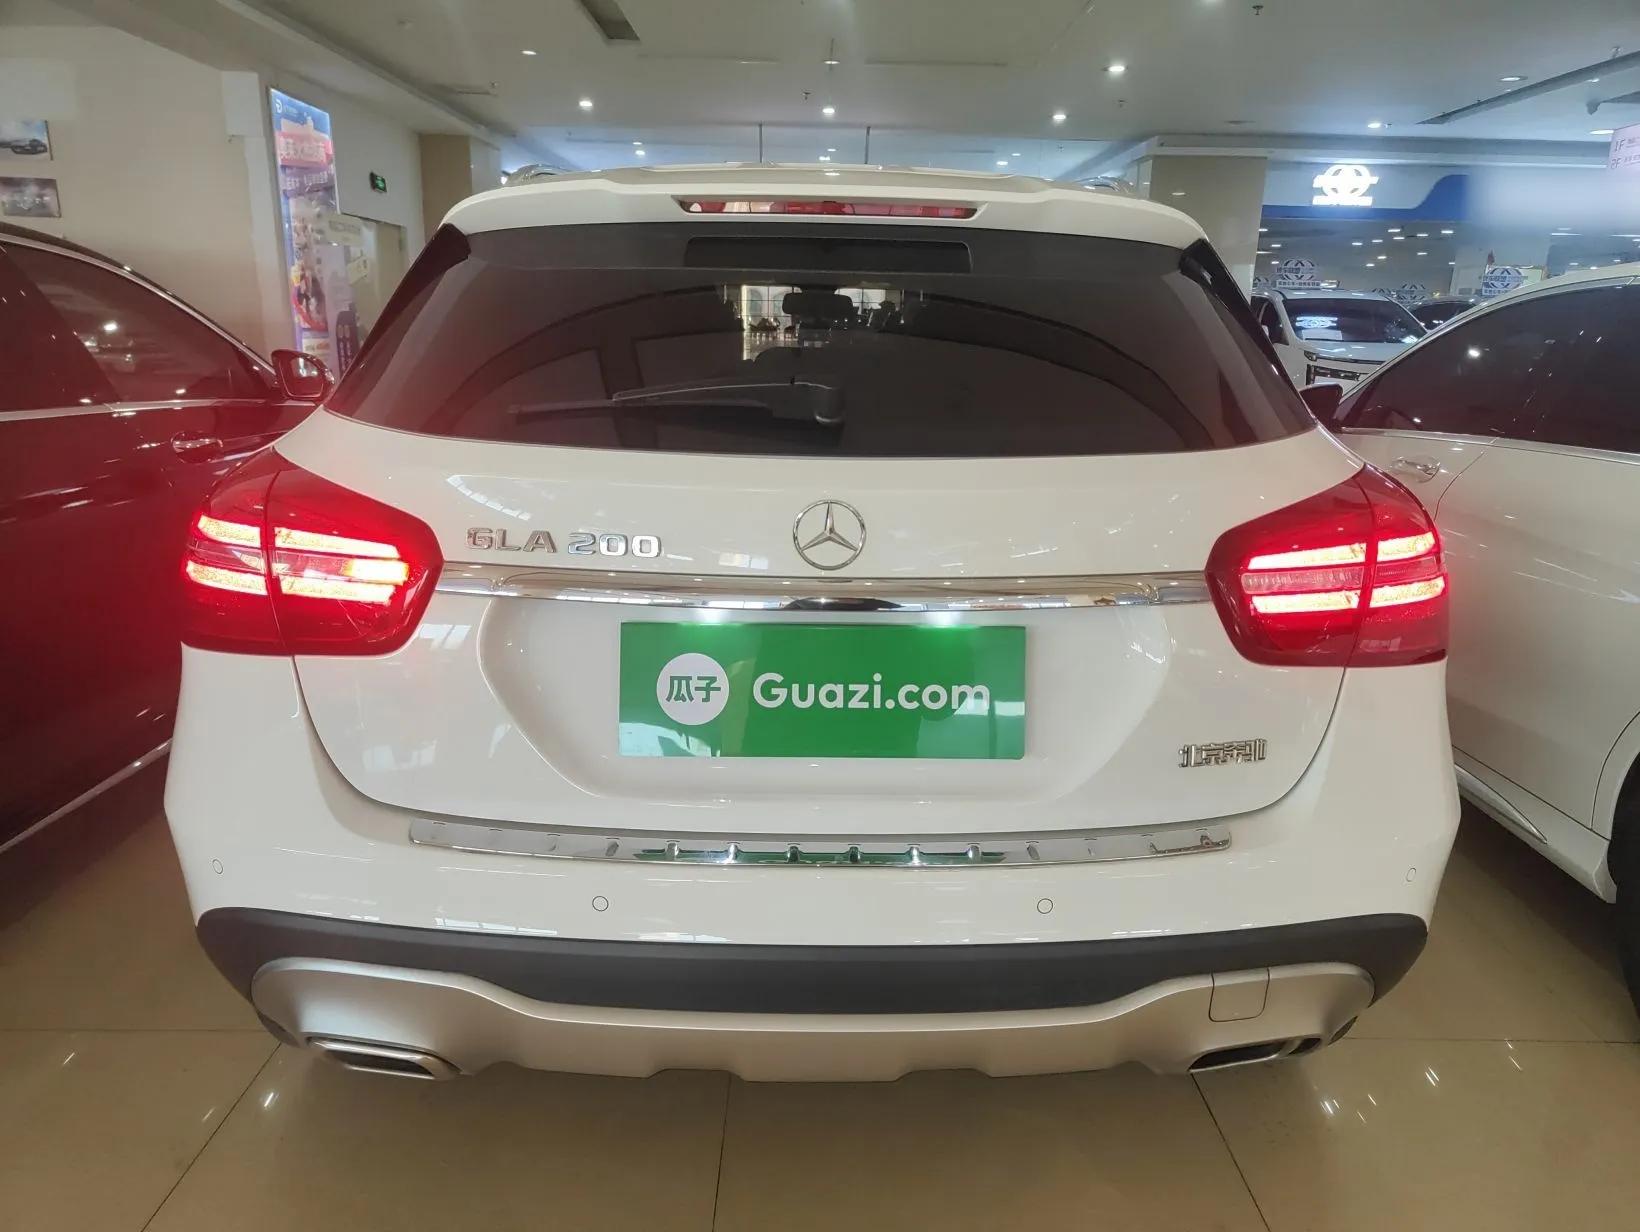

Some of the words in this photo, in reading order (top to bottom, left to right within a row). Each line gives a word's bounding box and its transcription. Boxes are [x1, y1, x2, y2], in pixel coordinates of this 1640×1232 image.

[466, 527, 557, 553] GLA
[567, 532, 662, 558] 200
[665, 675, 721, 703] 瓜子
[753, 672, 990, 709] Guazi.com
[1178, 738, 1267, 768] 北京奔驰
